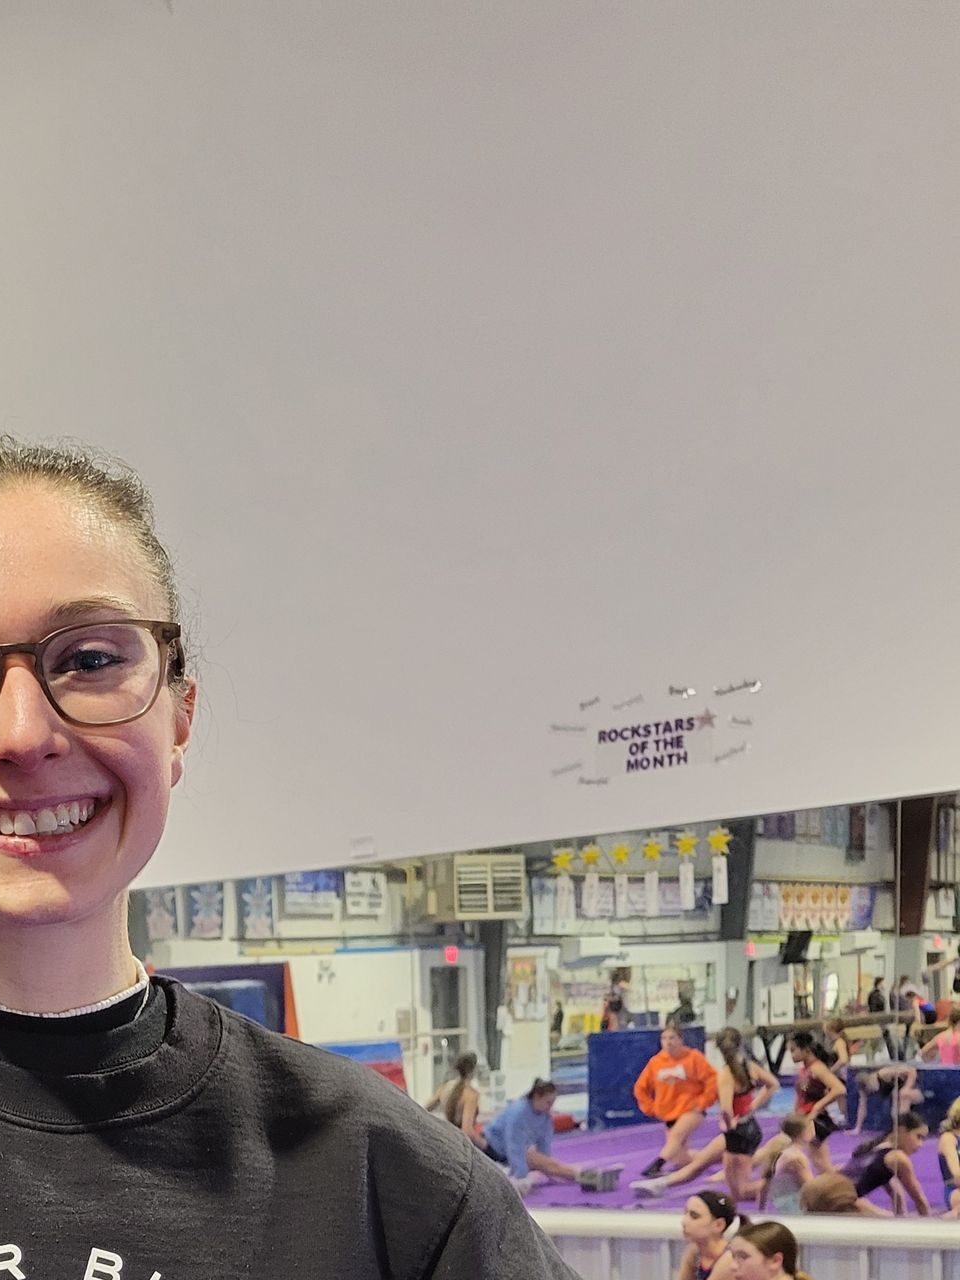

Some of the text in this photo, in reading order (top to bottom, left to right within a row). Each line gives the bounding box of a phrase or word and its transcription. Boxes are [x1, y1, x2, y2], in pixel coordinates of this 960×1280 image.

[597, 716, 696, 745] ROCKSTARS
[628, 735, 685, 757] OF THE
[626, 751, 689, 774] MONTH
